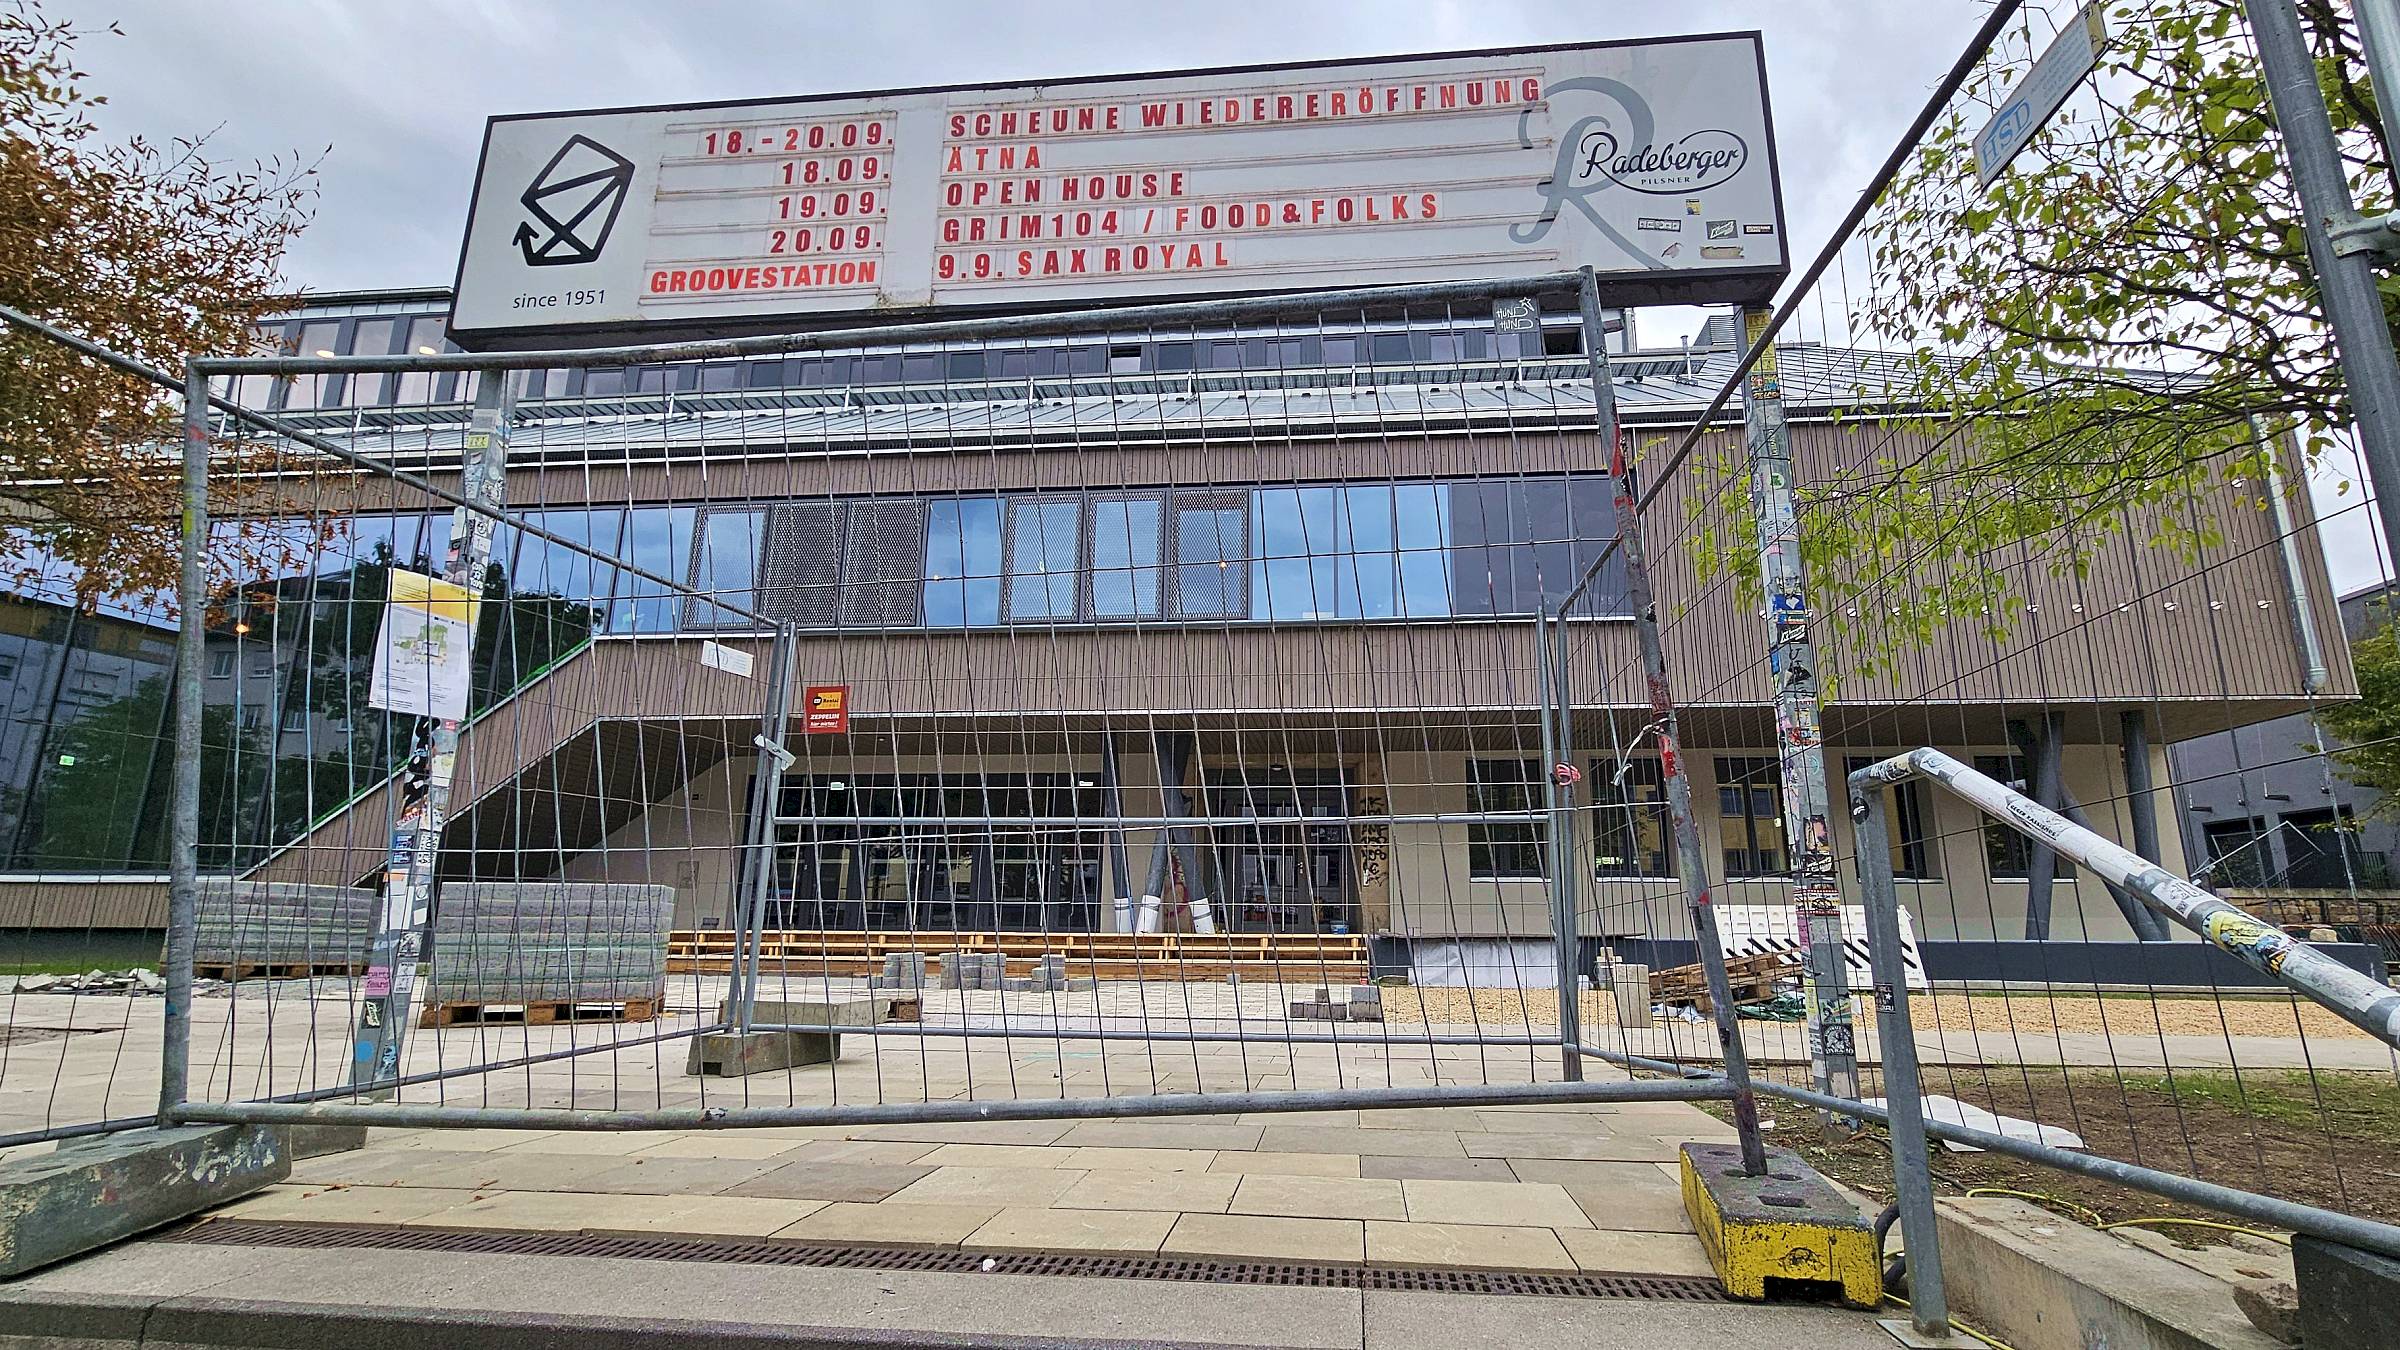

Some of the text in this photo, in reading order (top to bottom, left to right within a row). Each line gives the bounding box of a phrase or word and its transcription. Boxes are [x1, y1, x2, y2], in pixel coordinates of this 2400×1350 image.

[951, 78, 1539, 137] SCHEUNE WIEDERERÖFFNUNG
[1982, 101, 2031, 167] HSD
[783, 157, 889, 185] 18.09.
[947, 146, 1040, 173] ÄTNA
[1579, 131, 1740, 180] Radeberger
[947, 172, 1183, 206] OPEN HOUSE
[1641, 176, 1691, 186] PILSNER
[779, 191, 886, 219] 19.09.
[943, 210, 1118, 243] GRIM104
[1175, 194, 1437, 231] FOOD&FOLKS
[770, 226, 881, 254] 20.09.
[1018, 249, 1086, 276] SAX
[1105, 242, 1228, 272] ROYAL
[650, 261, 876, 293] GROOVESTATION
[512, 289, 606, 309] since 1951
